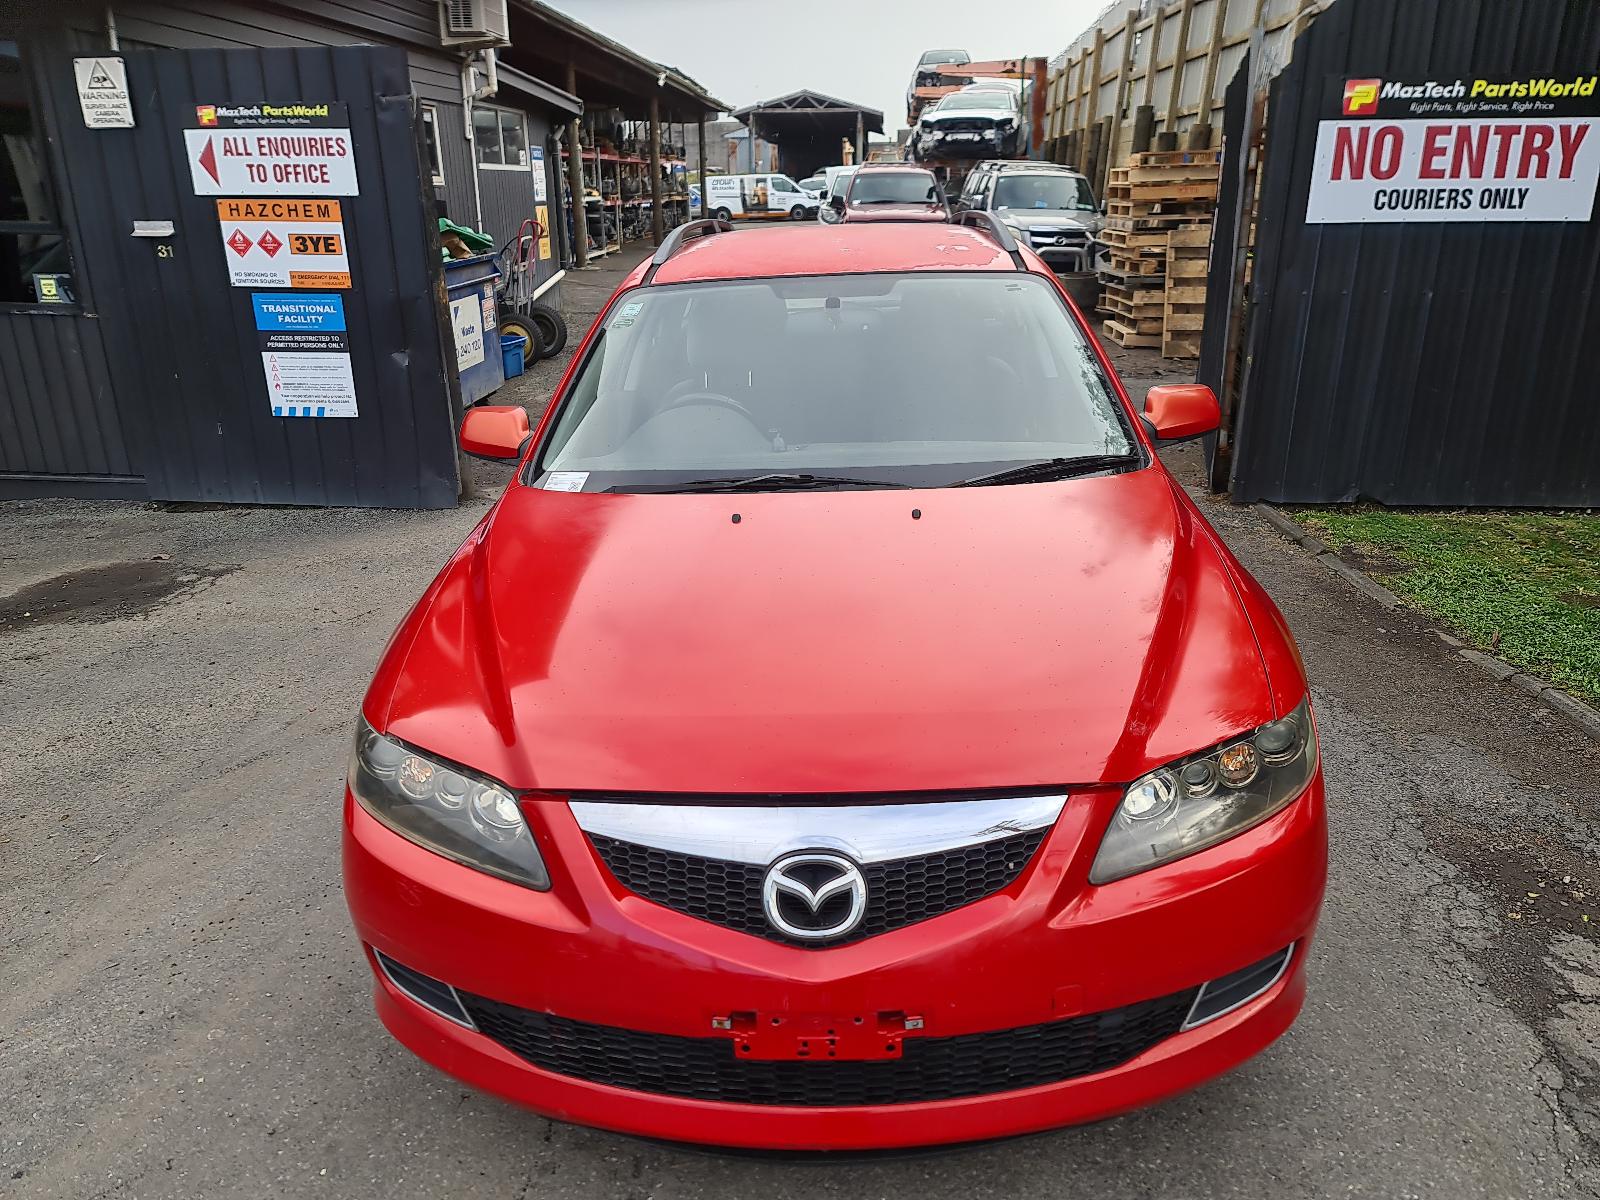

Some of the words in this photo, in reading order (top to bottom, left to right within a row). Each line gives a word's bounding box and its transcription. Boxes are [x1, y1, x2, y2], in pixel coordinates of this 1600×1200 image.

[1380, 80, 1466, 99] MazTech
[1470, 76, 1598, 98] PartsWorld
[80, 91, 127, 100] WARNING
[262, 104, 328, 117] PartsWorld
[1410, 102, 1431, 114] Right
[1455, 102, 1478, 114] Right
[1511, 101, 1533, 112] Right
[1534, 101, 1555, 111] Price
[223, 137, 253, 157] ALL
[256, 137, 347, 158] ENQUIRIES
[1330, 125, 1405, 181] NO
[1417, 124, 1591, 180] ENTRY
[246, 164, 268, 183] TO
[272, 164, 330, 184] OFFICE
[1373, 188, 1472, 210] COURIERS
[1478, 187, 1530, 210] ONLY
[228, 203, 331, 218] HAZCHEM
[158, 245, 174, 258] 31
[294, 236, 337, 253] 3YE
[260, 304, 337, 314] TRANSITIONAL
[278, 315, 324, 324] FACILITY
[460, 342, 471, 358] 240
